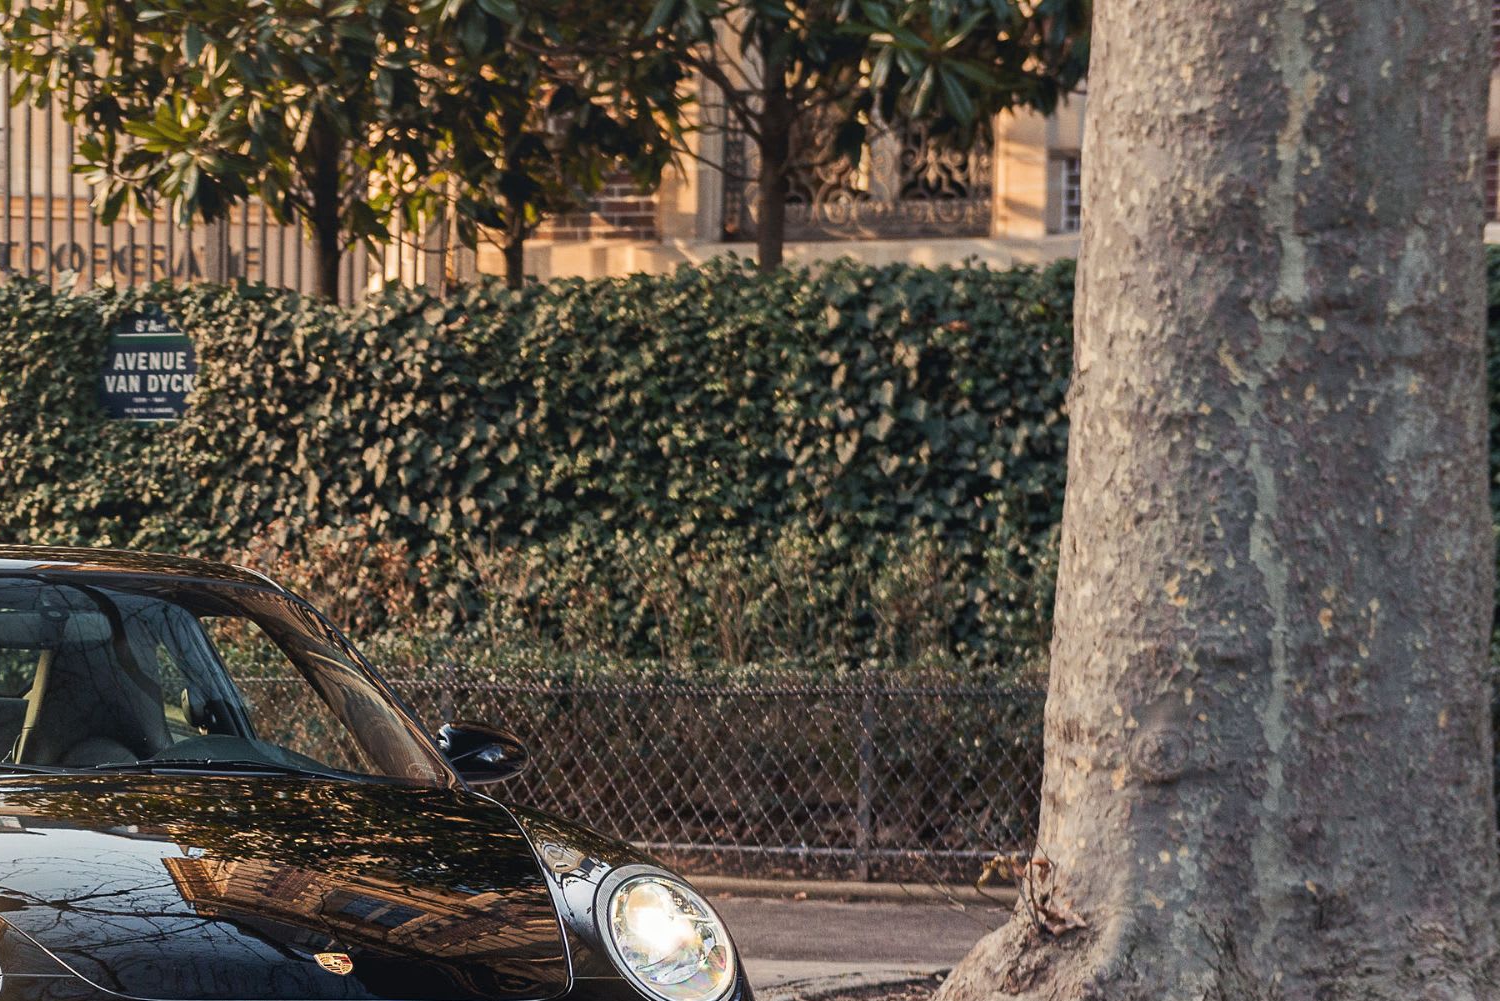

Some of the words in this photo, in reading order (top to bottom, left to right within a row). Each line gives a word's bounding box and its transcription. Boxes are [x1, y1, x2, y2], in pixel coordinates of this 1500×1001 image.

[113, 351, 187, 371] AVENUE
[104, 375, 141, 393] VAN
[146, 374, 196, 393] DYCK
